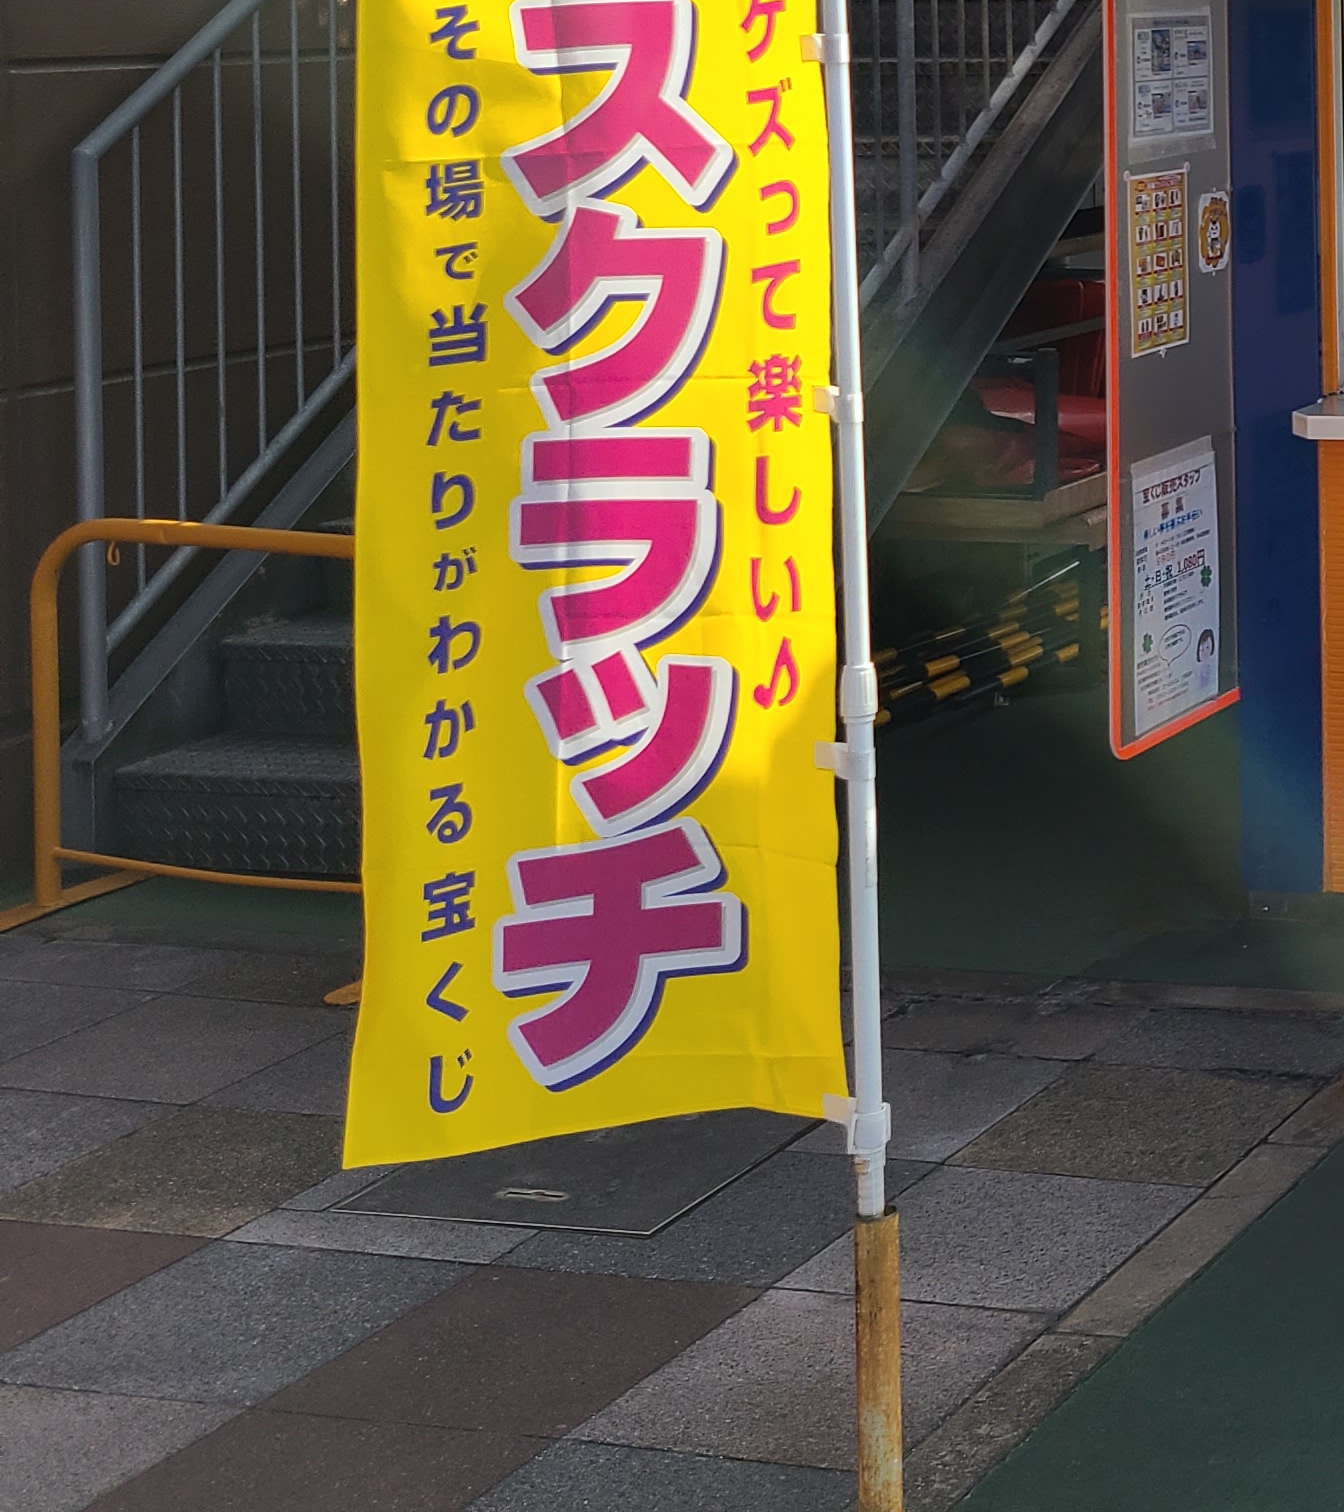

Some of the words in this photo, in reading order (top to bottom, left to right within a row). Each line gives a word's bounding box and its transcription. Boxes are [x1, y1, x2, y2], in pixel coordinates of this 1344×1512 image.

[420, 4, 486, 1115] その場で当たりがわかる宝くじ
